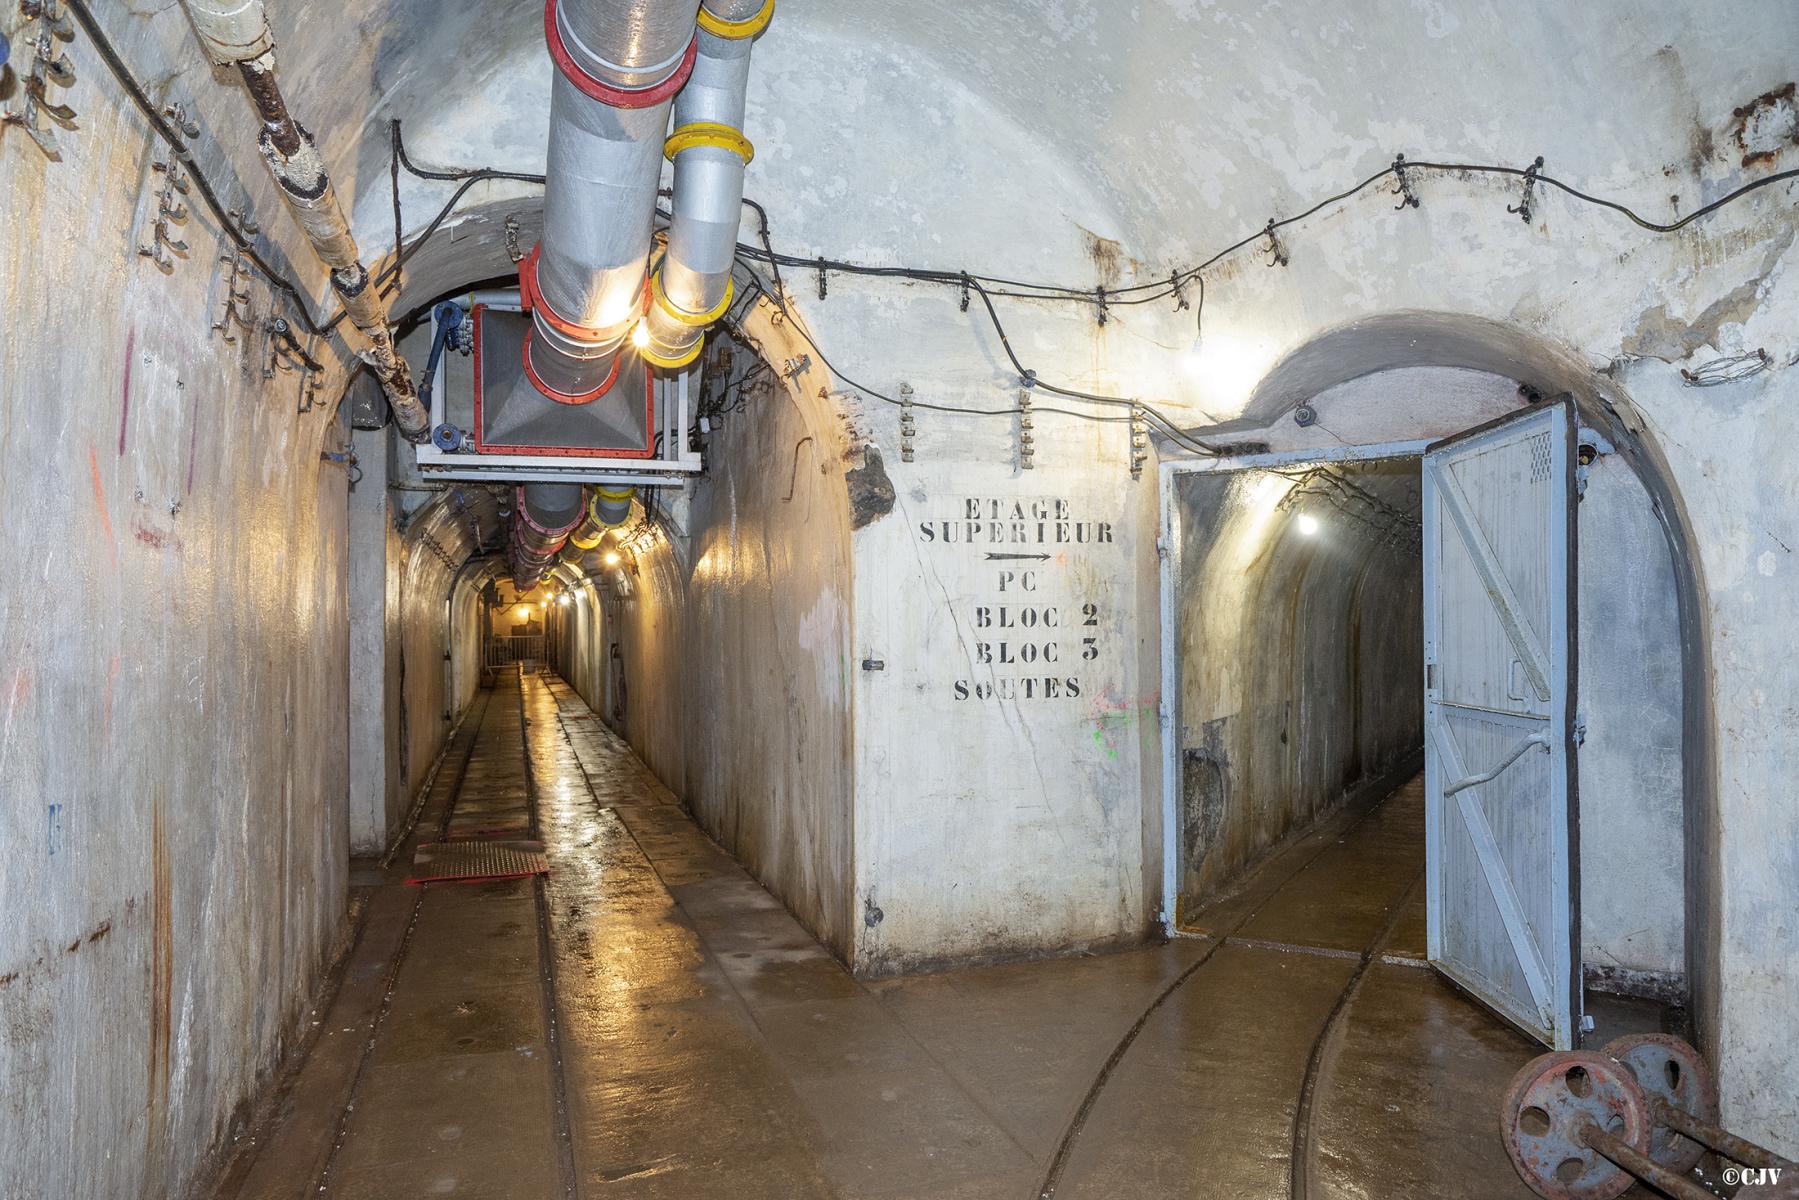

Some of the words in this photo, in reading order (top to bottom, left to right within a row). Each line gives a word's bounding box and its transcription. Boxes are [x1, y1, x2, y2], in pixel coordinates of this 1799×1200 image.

[964, 498, 1069, 520] ETAGE
[919, 521, 1113, 543] SUPERIEUR
[998, 570, 1036, 592] PC
[975, 607, 1058, 628] BLOC
[1082, 603, 1098, 626] 2
[975, 642, 1058, 664] BLOC
[1082, 637, 1099, 661] 3
[954, 677, 1080, 701] SOUTES
